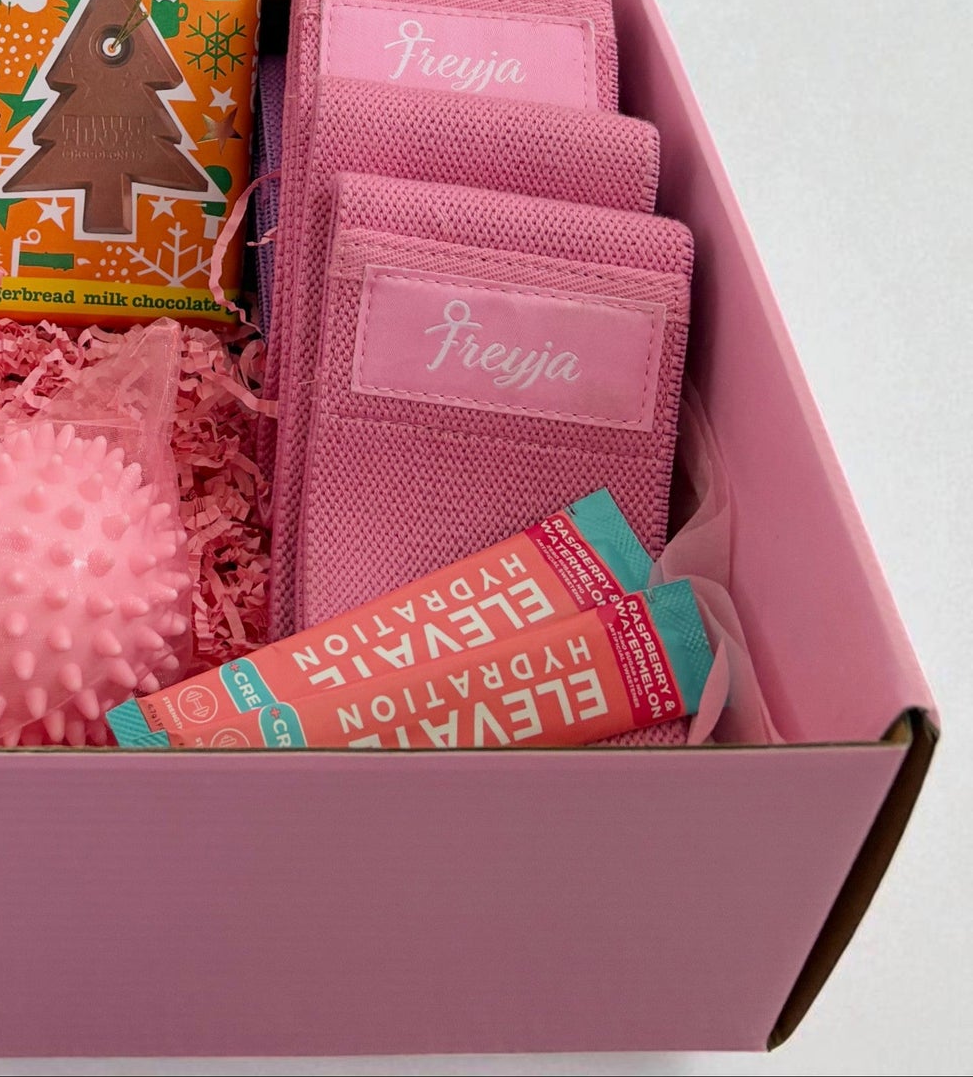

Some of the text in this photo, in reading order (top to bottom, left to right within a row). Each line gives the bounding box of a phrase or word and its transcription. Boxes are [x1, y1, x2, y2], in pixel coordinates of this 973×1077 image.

[384, 19, 527, 93] Freyja
[83, 291, 128, 307] milk
[132, 294, 221, 312] chocolate
[425, 299, 583, 390] Freyja
[552, 519, 621, 603] RASPBERRY &
[291, 553, 528, 672] HYDRATION
[615, 601, 663, 719] WATERMELON
[627, 600, 676, 711] RASPBERRY &
[337, 635, 593, 734] HYDRATION
